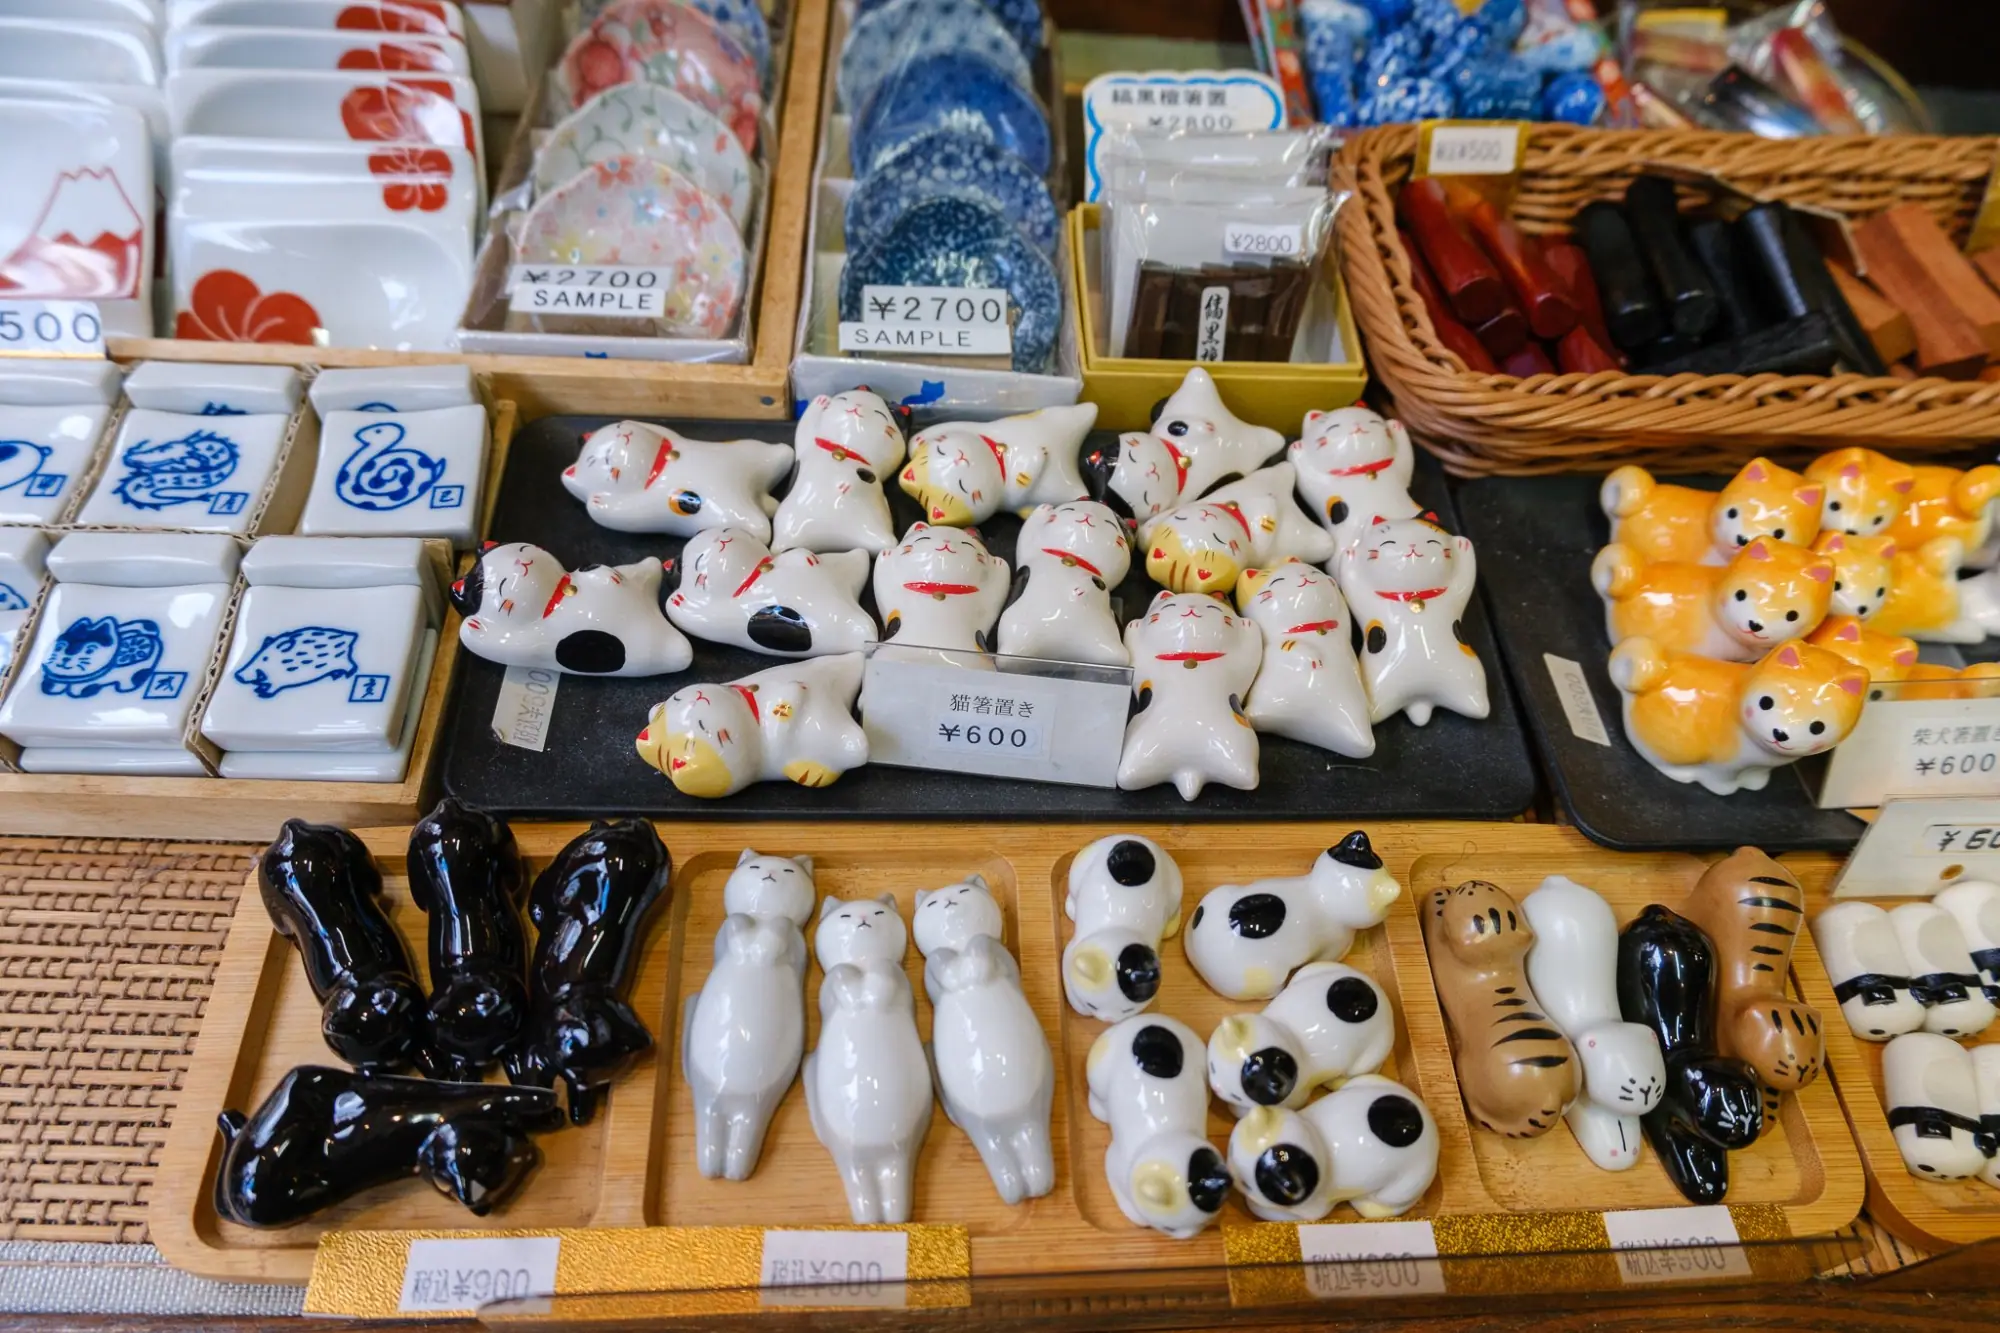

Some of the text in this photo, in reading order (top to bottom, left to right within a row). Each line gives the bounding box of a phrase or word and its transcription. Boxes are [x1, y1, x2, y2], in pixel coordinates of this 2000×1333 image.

[1231, 233, 1293, 253] ¥2800
[522, 269, 657, 288] ¥2700
[533, 289, 654, 310] SAMPLE
[868, 296, 1001, 323] ¥2700
[0, 311, 100, 343] 500
[855, 328, 972, 347] SAMPLE
[949, 693, 1036, 719] 猫箸置き
[938, 723, 1028, 748] ¥600
[1915, 753, 1997, 777] ¥600
